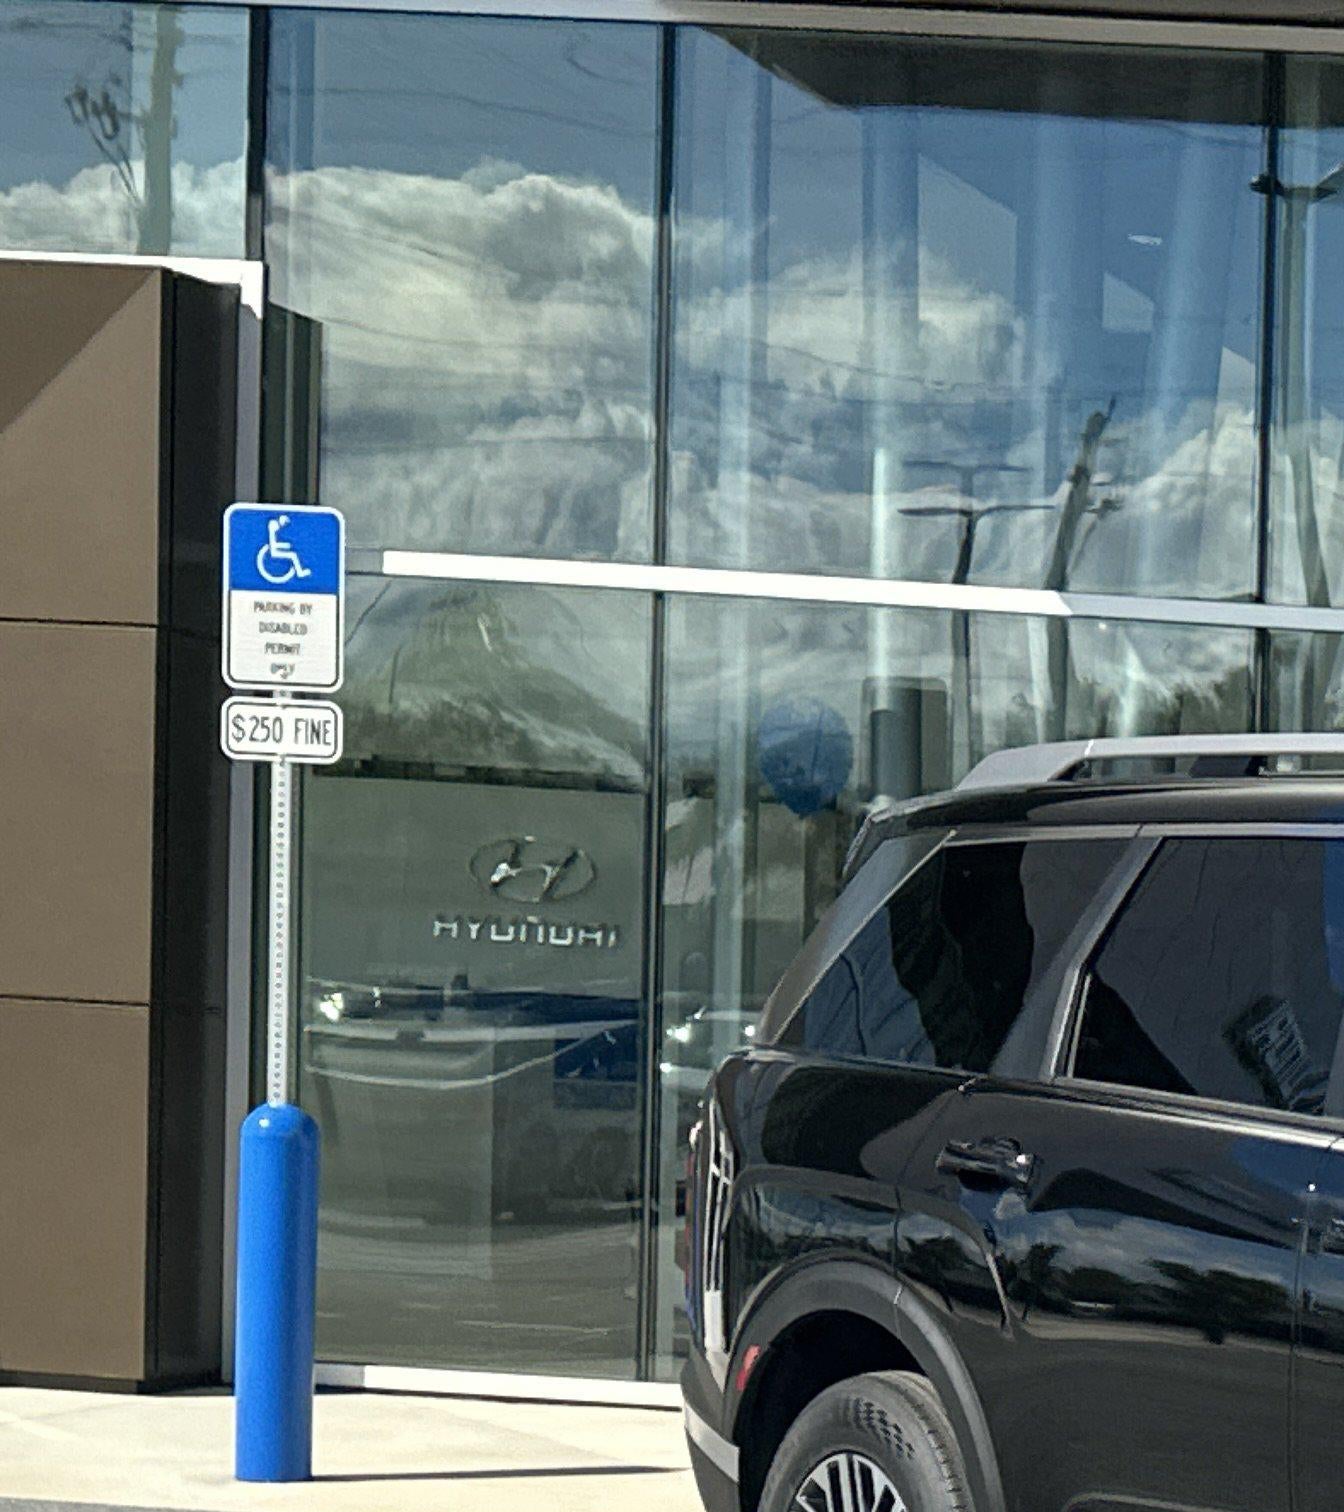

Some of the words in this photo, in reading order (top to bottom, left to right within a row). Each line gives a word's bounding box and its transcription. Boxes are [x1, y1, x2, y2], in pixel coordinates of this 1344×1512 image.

[254, 600, 295, 615] PARKING
[300, 603, 313, 615] BY
[259, 621, 308, 635] DISABLED
[264, 642, 301, 655] PERMIT
[231, 713, 284, 743] $250
[294, 717, 331, 746] FINE
[433, 914, 620, 948] HYUNDAI
